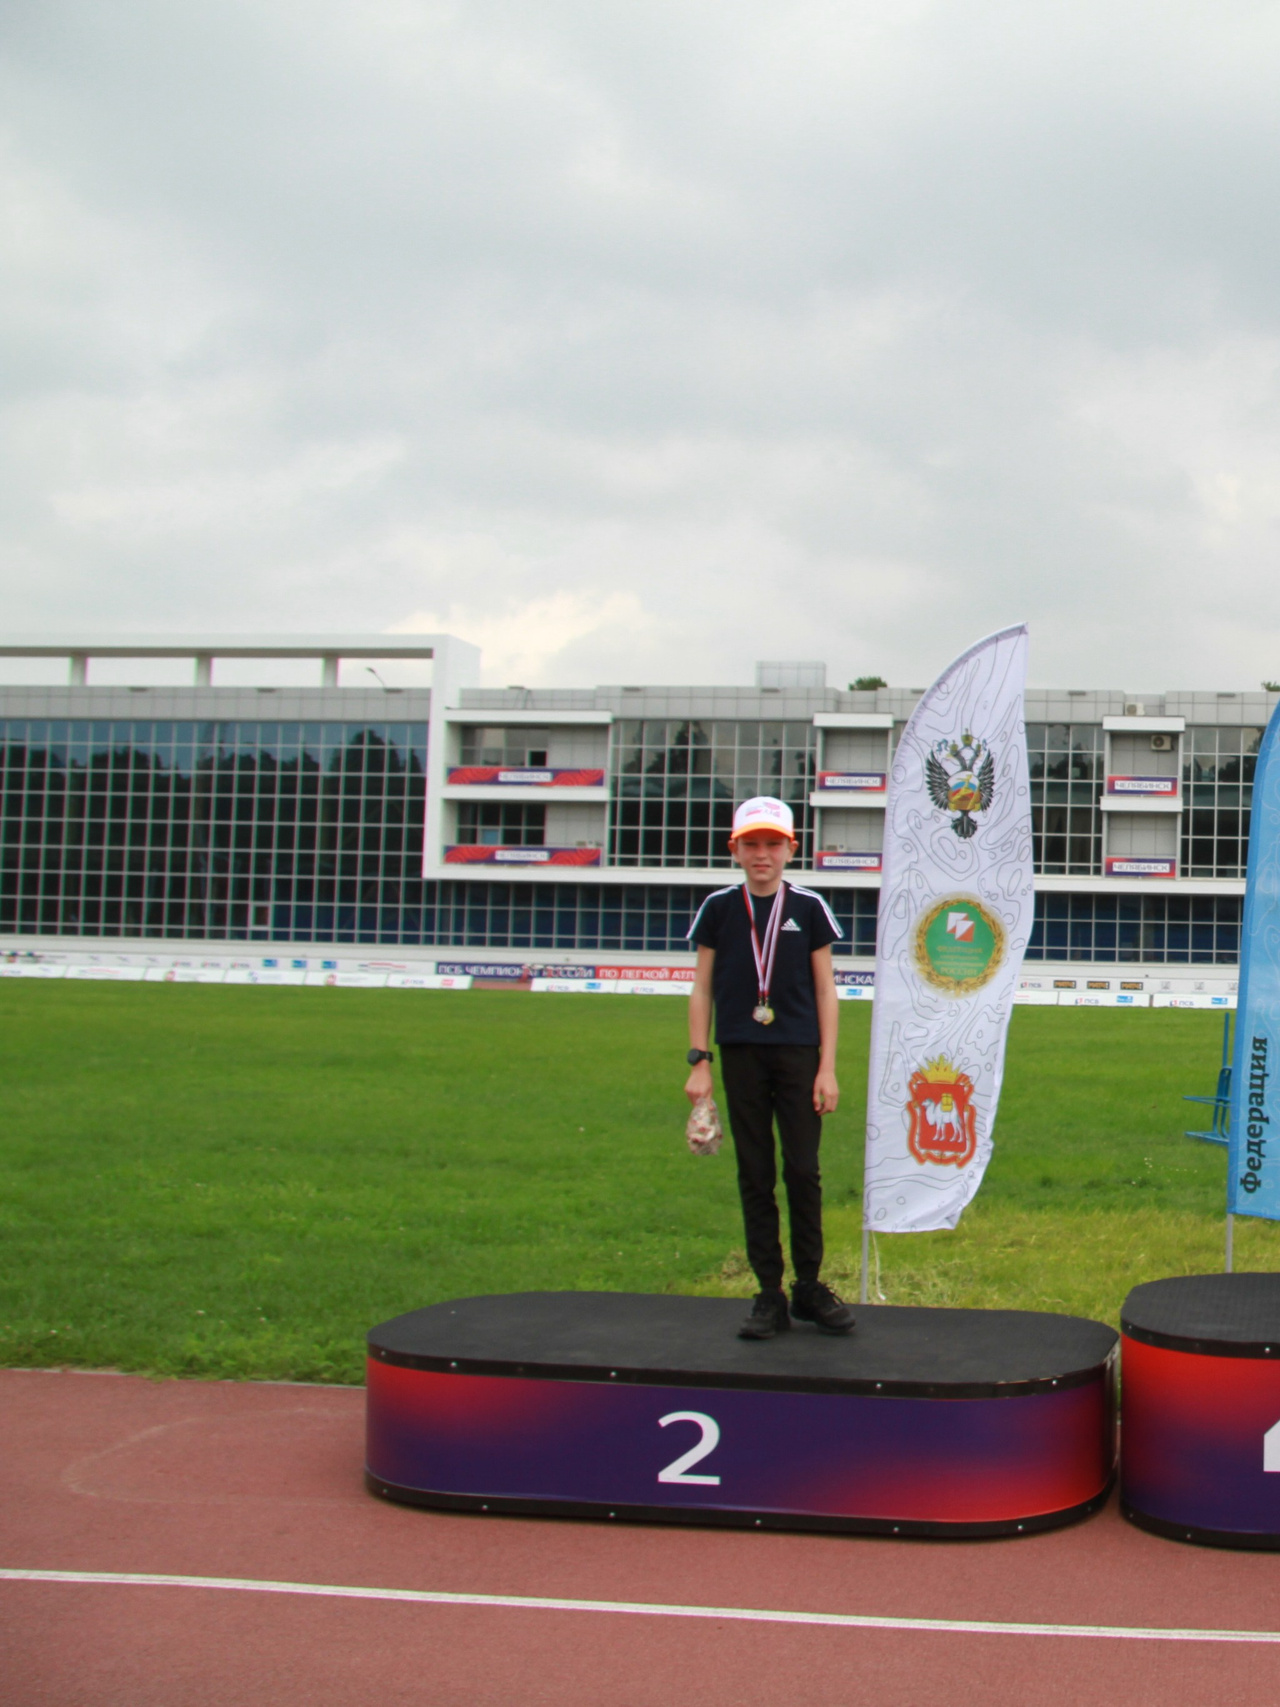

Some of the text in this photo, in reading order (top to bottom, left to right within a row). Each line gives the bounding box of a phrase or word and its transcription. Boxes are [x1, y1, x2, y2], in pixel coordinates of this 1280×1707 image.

[1115, 780, 1170, 791] ЧЕЛЯБИНСК
[824, 856, 878, 866] ЧЕЛЯБИНСК
[1113, 862, 1169, 872] ЧЕЛЯБИНСК
[599, 967, 619, 979] ПО
[620, 967, 670, 980] ЛЕГКОЙ
[1240, 1036, 1269, 1194] Федерация
[657, 1410, 721, 1485] 2
